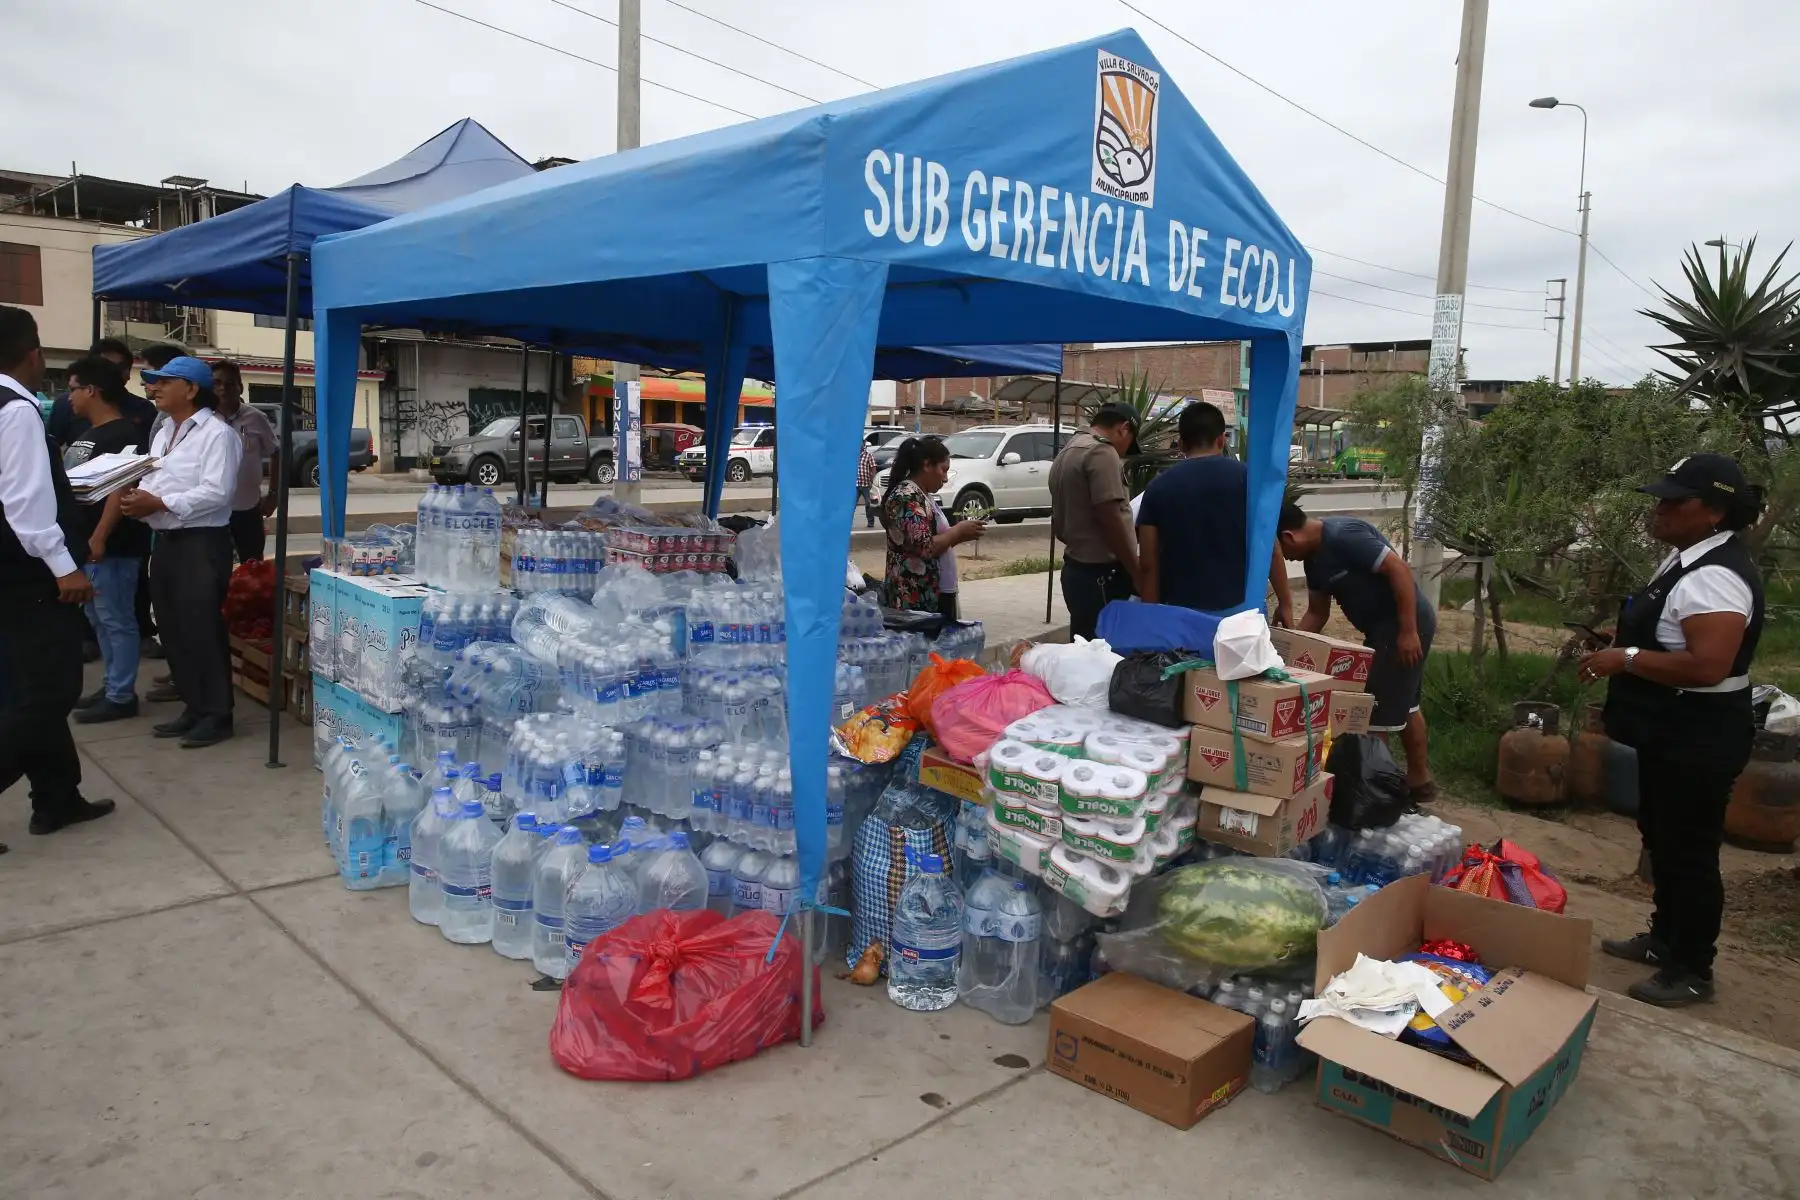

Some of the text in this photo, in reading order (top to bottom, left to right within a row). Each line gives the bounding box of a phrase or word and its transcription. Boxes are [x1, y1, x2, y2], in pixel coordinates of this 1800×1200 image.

[1099, 58, 1159, 91] VILLA EL SALVADOR
[1096, 177, 1149, 202] MUNICIPALIDAD
[864, 149, 1295, 318] SUB GERENCIA DE ECDJ
[613, 389, 621, 433] LUNA
[1195, 686, 1221, 699] SAN JORGE
[1200, 747, 1230, 759] SAN JORGE
[1004, 776, 1039, 799] NOBLE
[1077, 800, 1119, 815] NOBLE
[1005, 811, 1040, 831] NOBLE
[1074, 836, 1113, 857] NOBLE
[1333, 1087, 1359, 1104] CAJA
